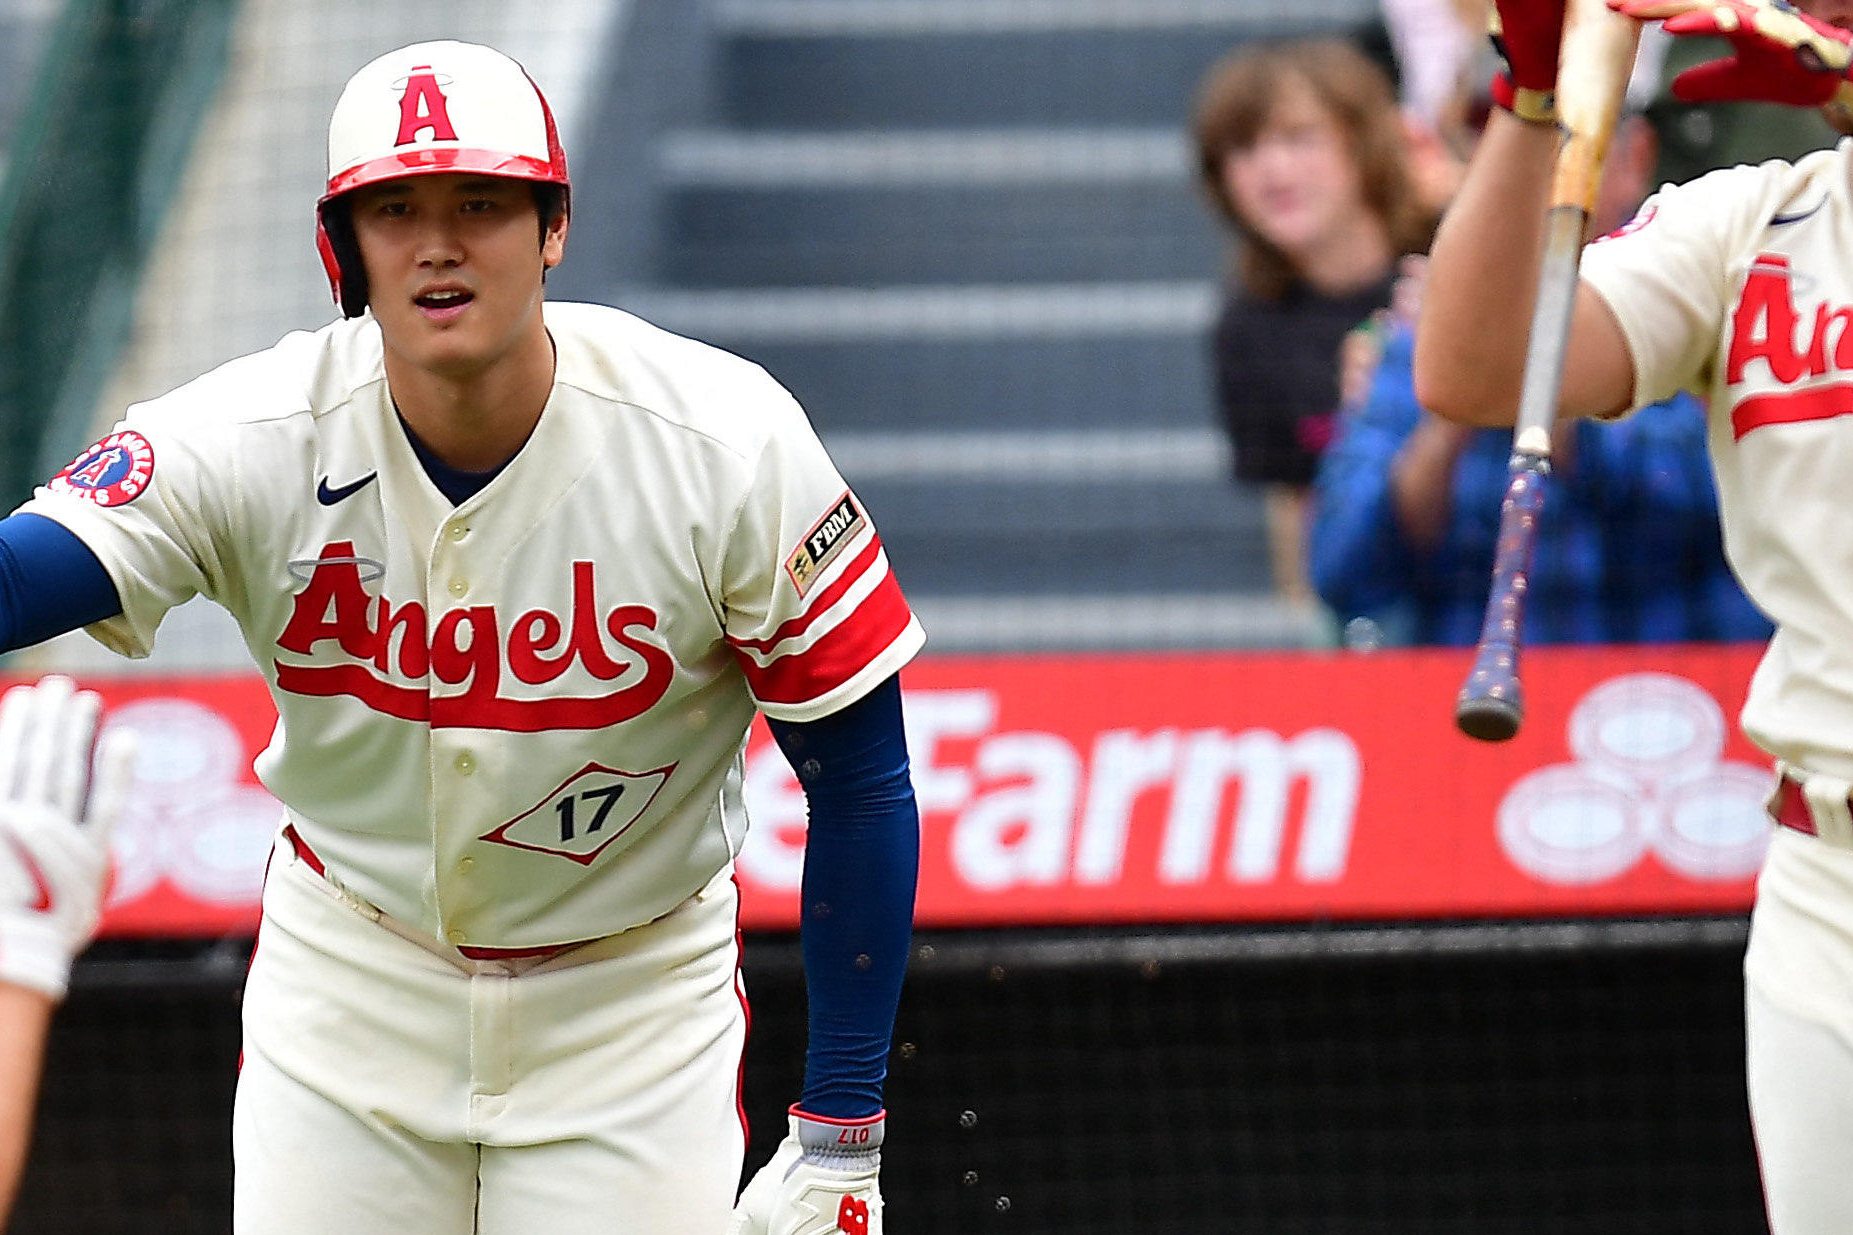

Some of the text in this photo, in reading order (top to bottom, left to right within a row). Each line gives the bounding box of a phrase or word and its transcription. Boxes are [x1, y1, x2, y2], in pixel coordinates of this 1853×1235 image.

[394, 65, 459, 147] A
[809, 502, 853, 557] FBM
[274, 540, 675, 733] Angels
[555, 783, 626, 842] 17
[837, 1127, 870, 1145] 017
